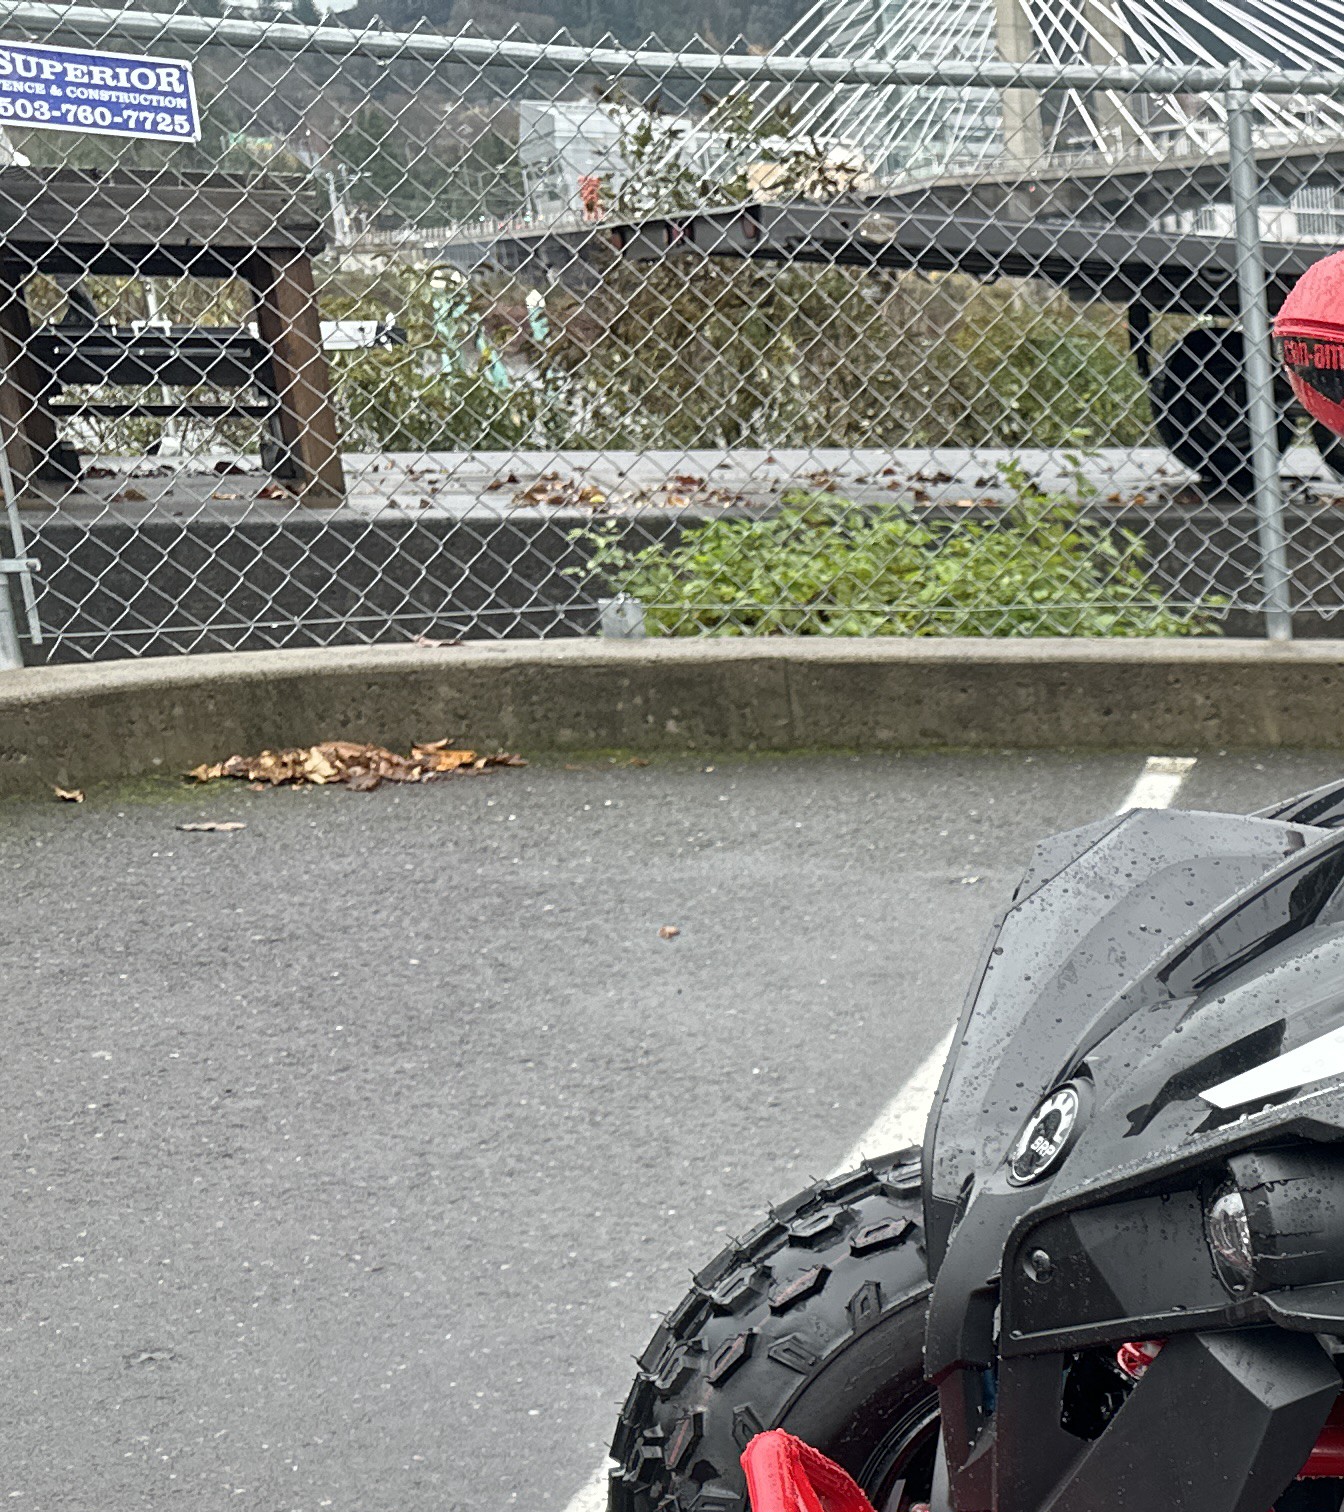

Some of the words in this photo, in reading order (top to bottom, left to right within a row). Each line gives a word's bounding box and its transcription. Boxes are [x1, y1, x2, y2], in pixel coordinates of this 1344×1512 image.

[0, 51, 185, 93] SUPERIOR
[50, 84, 63, 97] &
[66, 86, 187, 109] CONSTRUCTION
[0, 97, 191, 134] 503-760-7725
[1031, 1135, 1056, 1157] BRP
